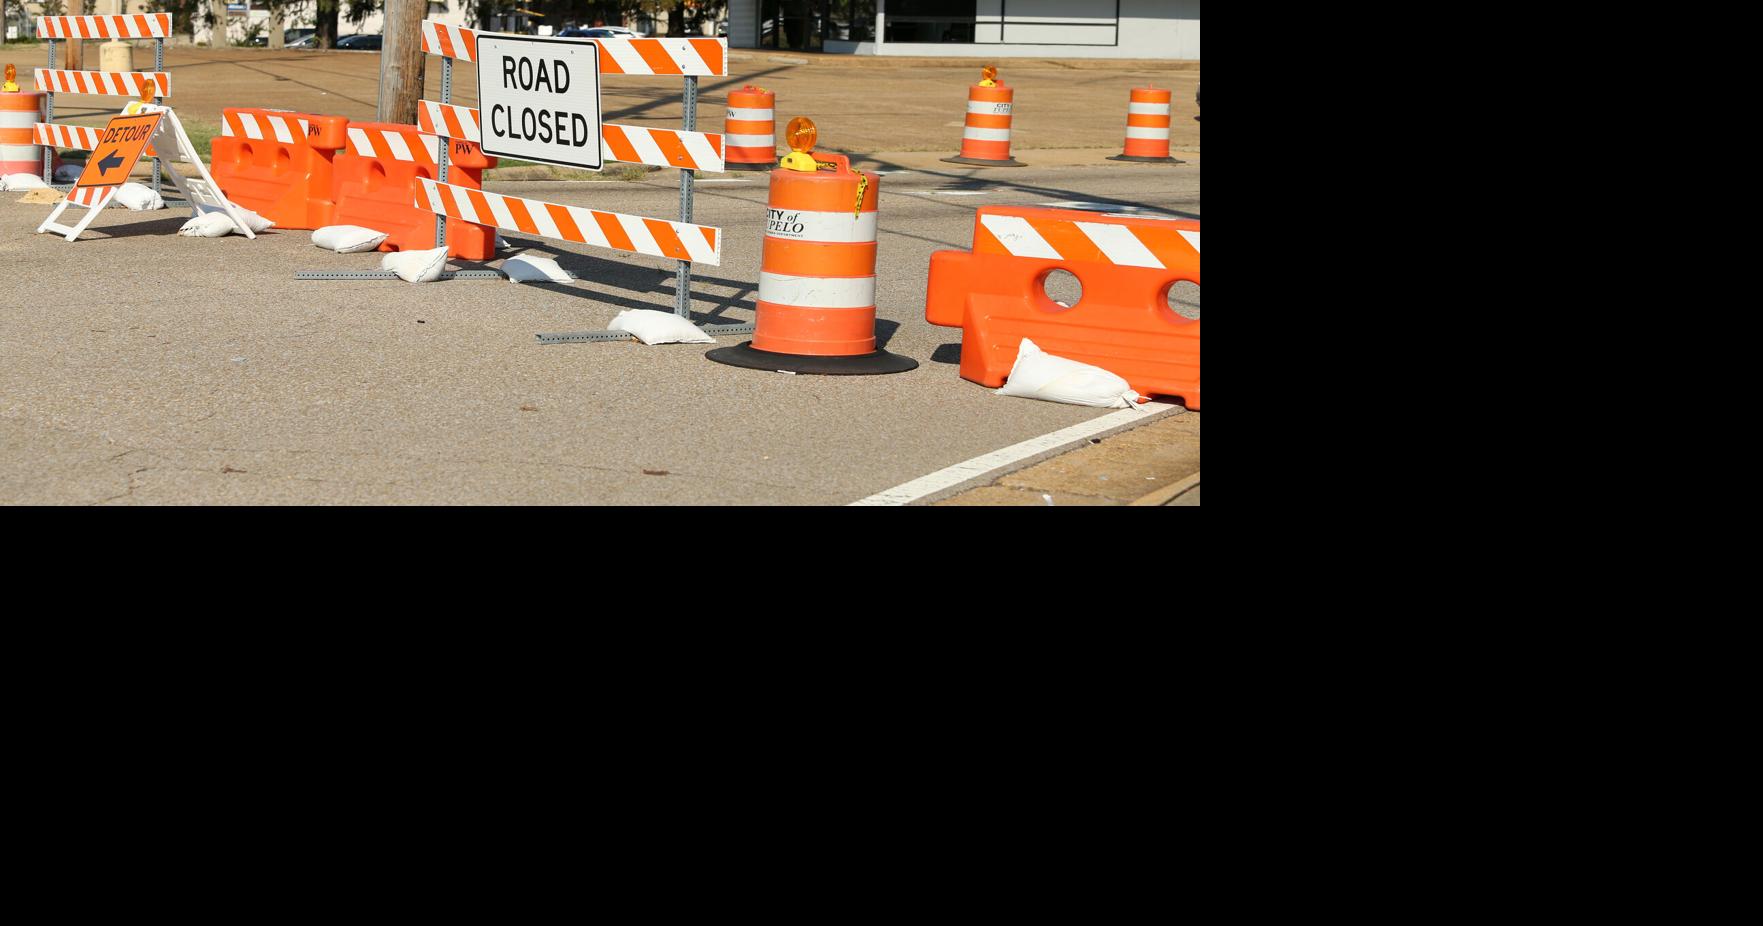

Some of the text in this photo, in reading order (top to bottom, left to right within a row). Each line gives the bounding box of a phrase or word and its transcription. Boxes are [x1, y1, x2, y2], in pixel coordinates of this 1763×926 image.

[502, 55, 570, 94] ROAD
[308, 125, 322, 137] PW
[491, 103, 588, 147] CLOSED
[103, 124, 151, 144] DETOUR
[455, 143, 475, 155] PW
[787, 212, 801, 224] of
[769, 219, 805, 234] PELO
